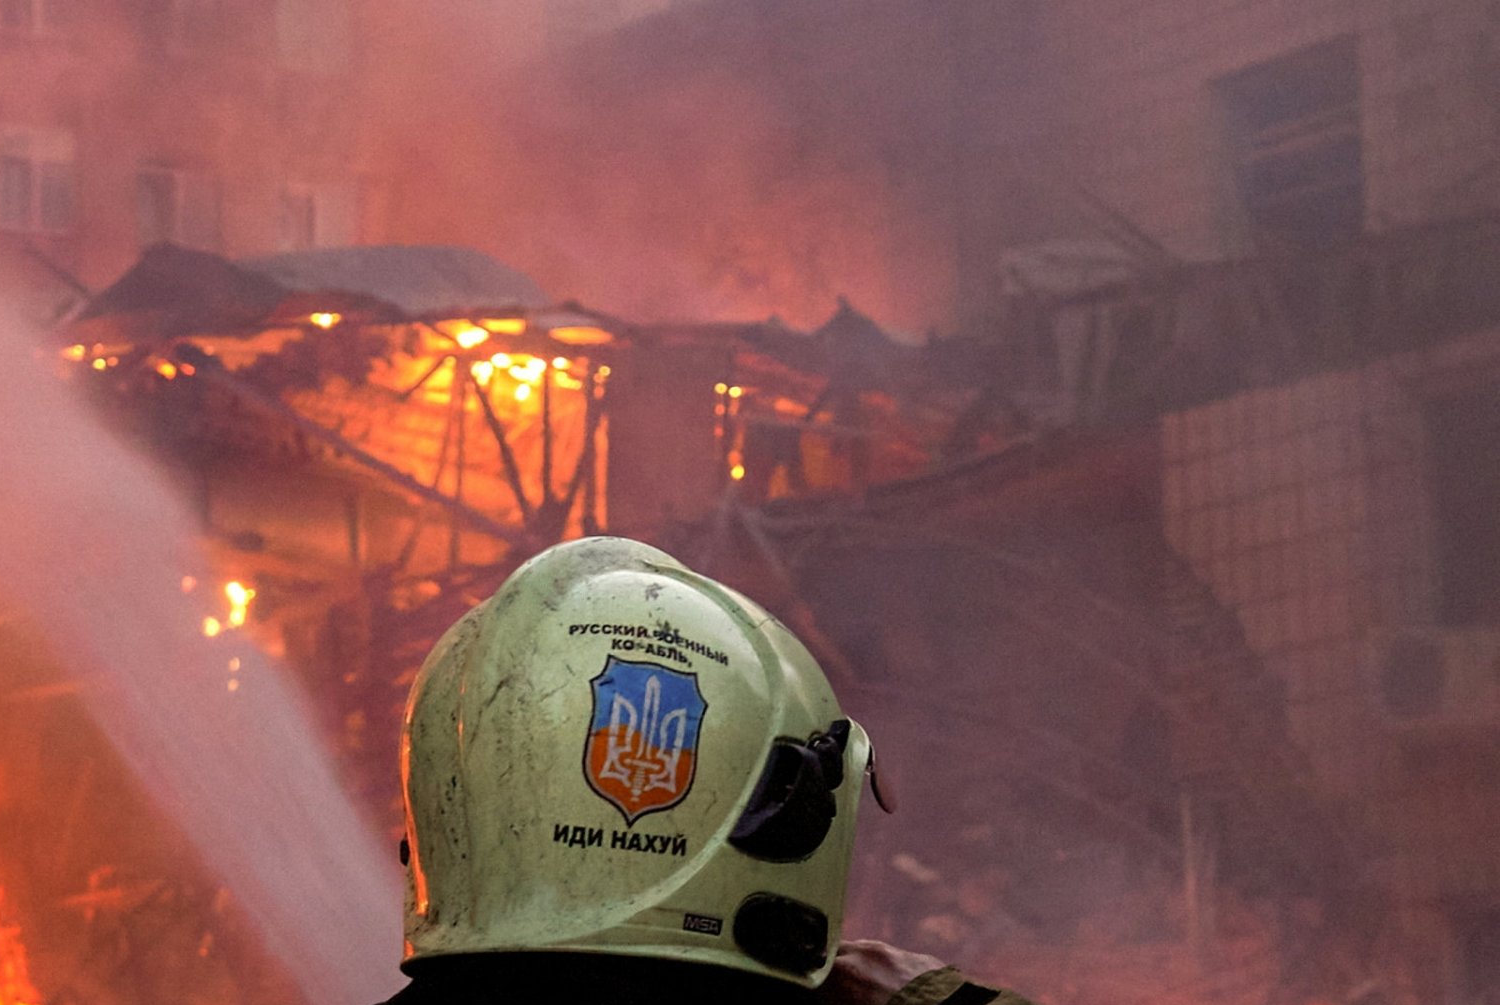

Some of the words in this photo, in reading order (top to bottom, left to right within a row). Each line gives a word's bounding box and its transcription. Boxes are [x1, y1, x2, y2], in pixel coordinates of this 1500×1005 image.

[569, 624, 648, 638] РУССКИЙ
[611, 638, 693, 667] КОАБЛЬ,
[553, 824, 604, 848] ИДИ
[611, 831, 687, 856] НАХУЙ
[685, 915, 719, 934] MSA
